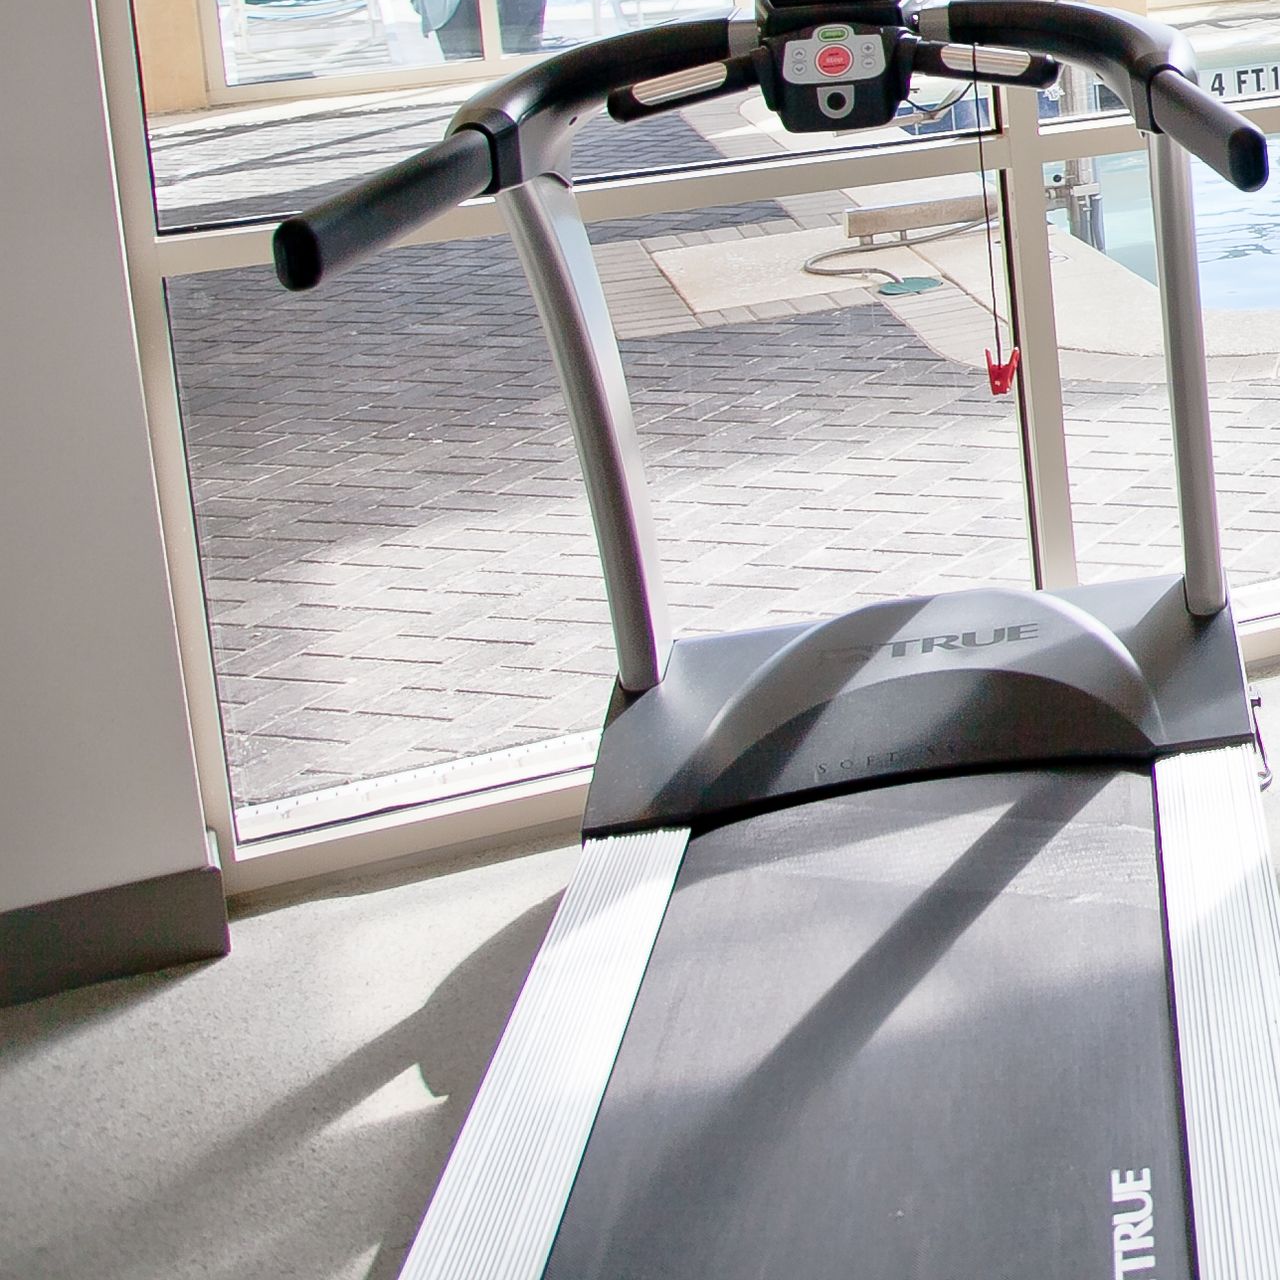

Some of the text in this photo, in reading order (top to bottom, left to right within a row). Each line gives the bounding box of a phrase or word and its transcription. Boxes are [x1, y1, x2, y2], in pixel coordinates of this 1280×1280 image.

[1210, 73, 1226, 96] 4
[1236, 67, 1267, 94] FT.
[882, 622, 1040, 659] TRUE
[817, 750, 898, 775] SOFT
[1109, 1166, 1157, 1280] TRUE
